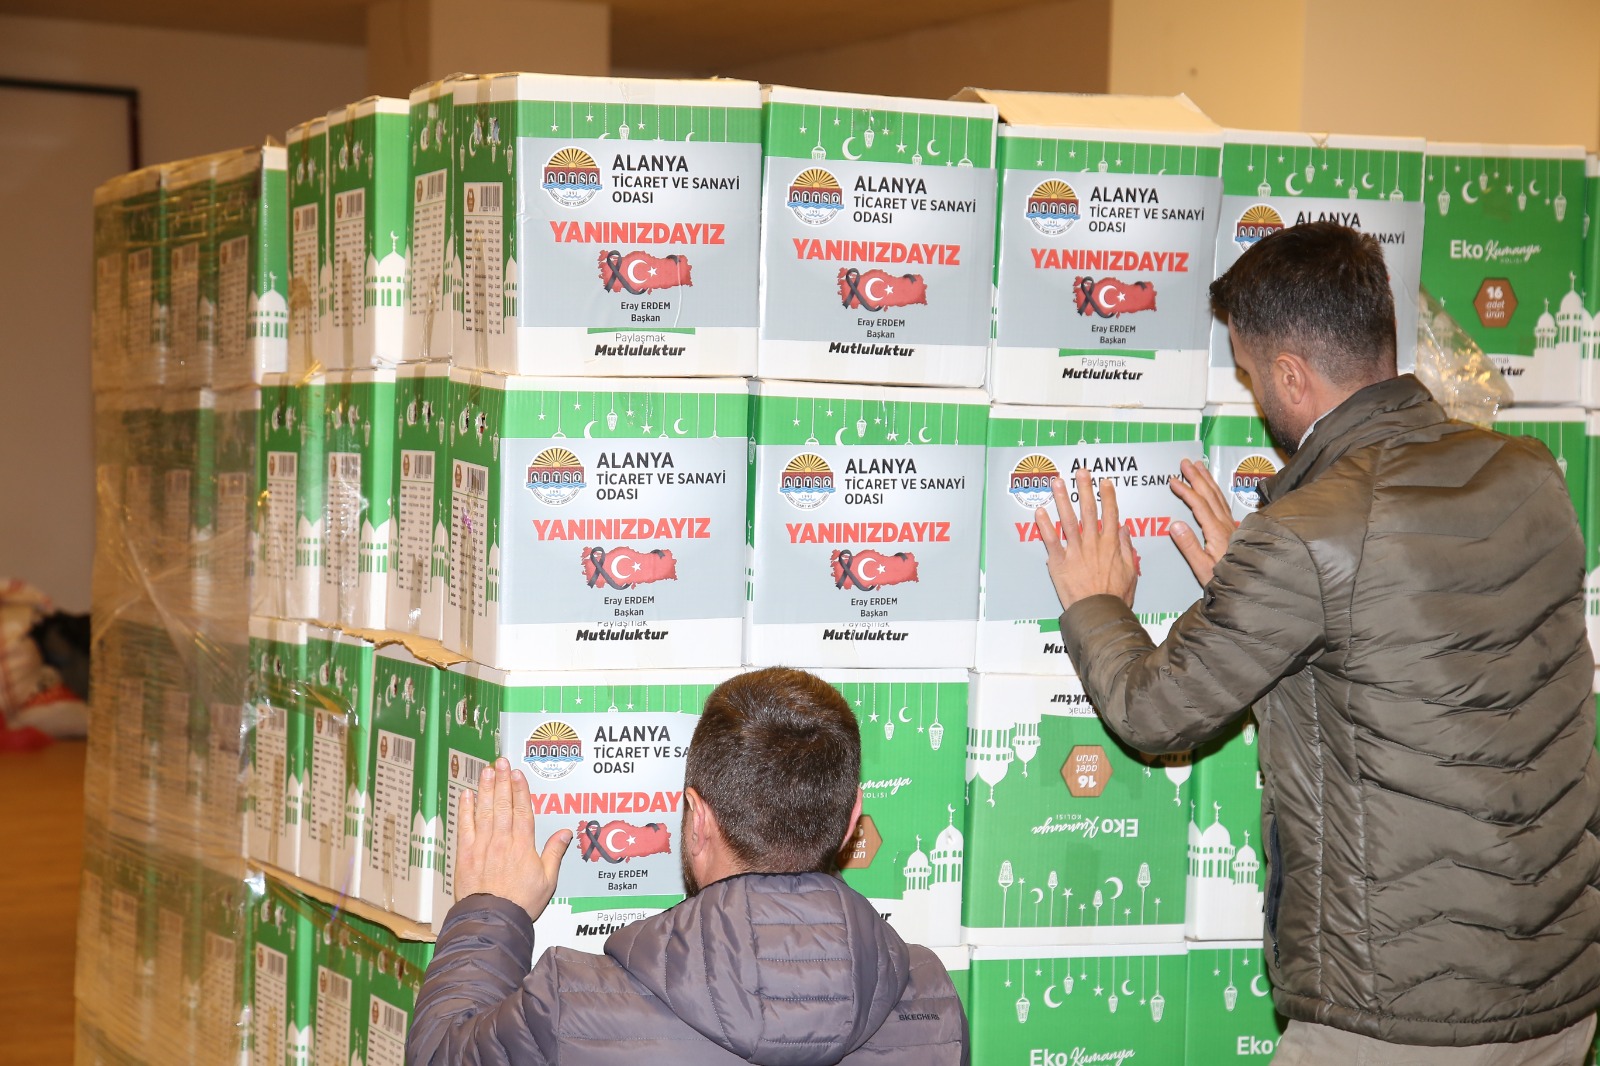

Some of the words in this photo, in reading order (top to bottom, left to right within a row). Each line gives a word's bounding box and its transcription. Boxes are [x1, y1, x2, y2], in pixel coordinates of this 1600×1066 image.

[612, 154, 689, 172] ALANYA
[547, 173, 597, 184] ALTSO
[612, 175, 669, 189] TİCARET
[672, 177, 689, 189] VE
[692, 175, 740, 190] SANAYİ
[854, 176, 927, 194] ALANYA
[612, 191, 654, 204] ODASI
[1090, 186, 1160, 204] ALANYA
[854, 194, 907, 210] TİCARET
[910, 199, 927, 211] VE
[930, 199, 976, 213] SANAYİ
[853, 211, 893, 224] ODASI
[1090, 204, 1141, 219] TİCARET
[1143, 208, 1158, 219] VE
[1161, 207, 1205, 221] SANAYİ
[549, 221, 726, 245] YANINIZDAYIZ
[1088, 220, 1126, 233] ODASI
[1371, 231, 1405, 244] ANAYİ
[792, 238, 961, 266] YANINIZDAYIZ
[1450, 239, 1484, 259] Eko
[1485, 239, 1541, 262] Kumanya
[1030, 248, 1190, 272] YANINIZDAYIZ
[1486, 286, 1503, 299] 16
[620, 301, 639, 312] Eray
[641, 301, 671, 310] ERDEM
[1486, 300, 1505, 309] adet
[630, 314, 661, 323] Başkan
[857, 318, 875, 328] Eray
[876, 319, 905, 327] ERDEM
[866, 330, 895, 339] Başkan
[1091, 325, 1108, 334] Eray
[1109, 325, 1136, 333] ERDEM
[615, 332, 666, 344] Paylaşmak
[1099, 336, 1126, 345] Başkan
[594, 344, 686, 357] Mutluluktur
[829, 342, 915, 357] Mutluluktur
[1081, 357, 1126, 368] Paylaşmak
[1062, 368, 1143, 380] Mutluluktur
[596, 452, 674, 469] ALANYA
[845, 458, 917, 474] ALANYA
[1071, 456, 1138, 473] ALANYA
[532, 472, 581, 483] ALTSO
[596, 471, 653, 485] TİCARET
[657, 473, 674, 485] VE
[678, 470, 726, 484] SANAYİ
[785, 477, 831, 488] ALTSO
[845, 476, 897, 490] TİCARET
[901, 479, 917, 490] VE
[920, 475, 965, 490] SANAYİ
[1123, 476, 1138, 487] VE
[596, 488, 638, 500] ODASI
[845, 493, 883, 505] ODASI
[532, 518, 711, 541] YANINIZDAYIZ
[785, 521, 951, 544] YANINIZDAYIZ
[604, 597, 622, 606] Eray
[624, 596, 655, 605] ERDEM
[851, 598, 868, 607] Eray
[870, 597, 898, 605] ERDEM
[614, 608, 644, 617] Başkan
[860, 609, 888, 618] Başkan
[576, 629, 668, 641] Mutluluktur
[822, 629, 909, 641] Mutluluktur
[594, 726, 671, 742] ALANYA
[530, 746, 579, 757] ALTSO
[593, 744, 649, 758] TİCARET
[653, 746, 670, 758] VE
[1076, 754, 1099, 765] ürün
[593, 762, 634, 773] ODASI
[1075, 764, 1098, 774] adet
[859, 776, 912, 795] umanya
[1077, 775, 1097, 788] 16
[530, 791, 683, 815] YANINIZDAY
[1031, 815, 1100, 839] Kumanya
[1101, 818, 1139, 838] Eko
[598, 870, 616, 879] Eray
[618, 869, 648, 878] ERDEM
[608, 882, 638, 891] Başkan
[597, 911, 647, 922] Paylaşmak
[899, 1013, 940, 1021] SKECHERS
[1236, 1036, 1274, 1055] Eko
[1030, 1048, 1068, 1066] Eko
[1070, 1046, 1136, 1066] Kumanya
